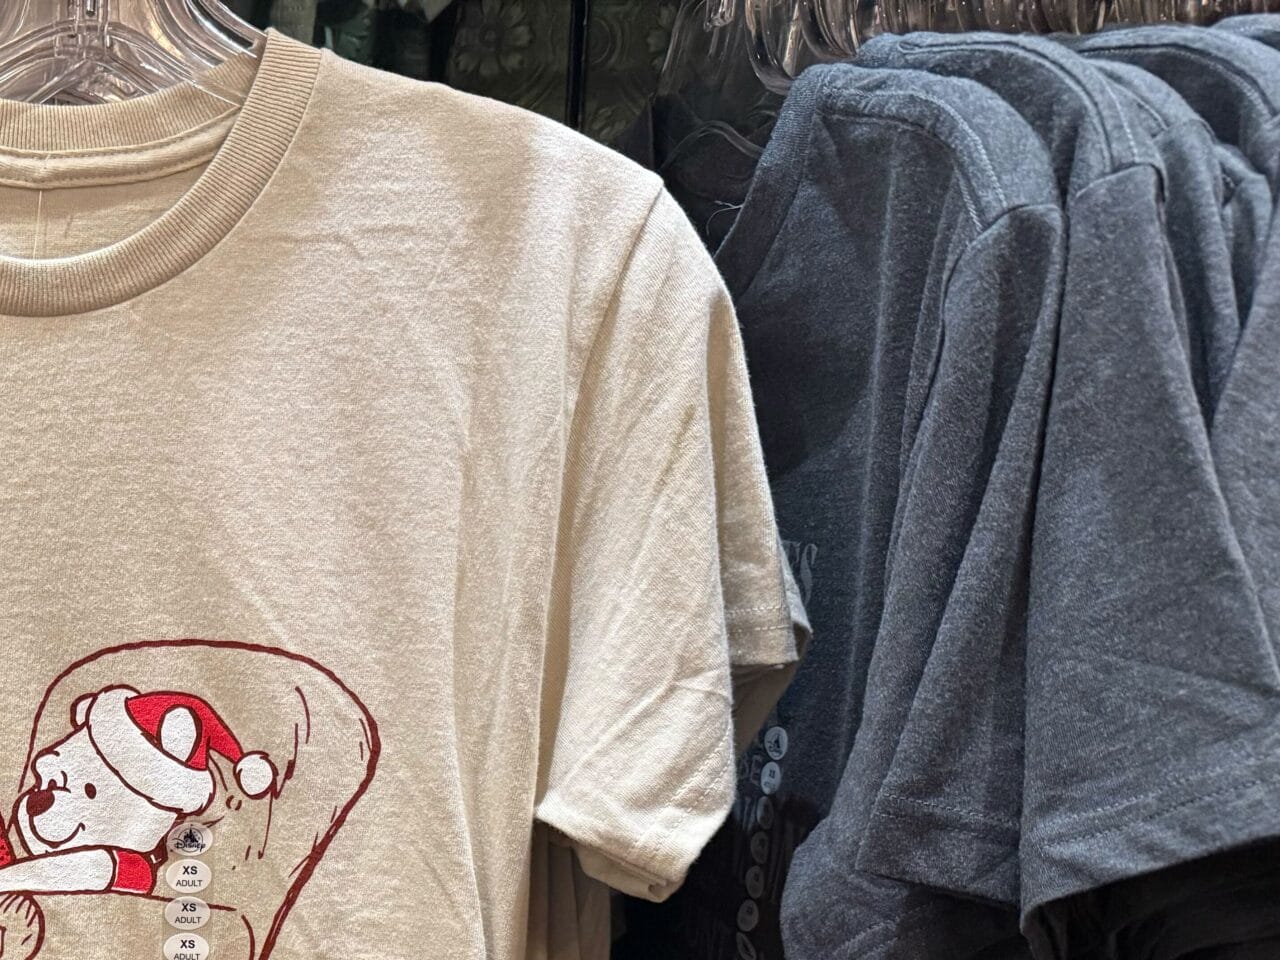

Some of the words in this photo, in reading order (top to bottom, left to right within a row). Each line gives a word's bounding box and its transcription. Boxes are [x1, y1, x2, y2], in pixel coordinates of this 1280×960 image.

[172, 838, 206, 852] Disney
[182, 865, 198, 875] XS
[175, 879, 203, 887] ADULT
[181, 903, 197, 912] XS
[174, 916, 202, 924] ADULT
[180, 939, 195, 949] XS
[173, 953, 200, 960] ADULT
